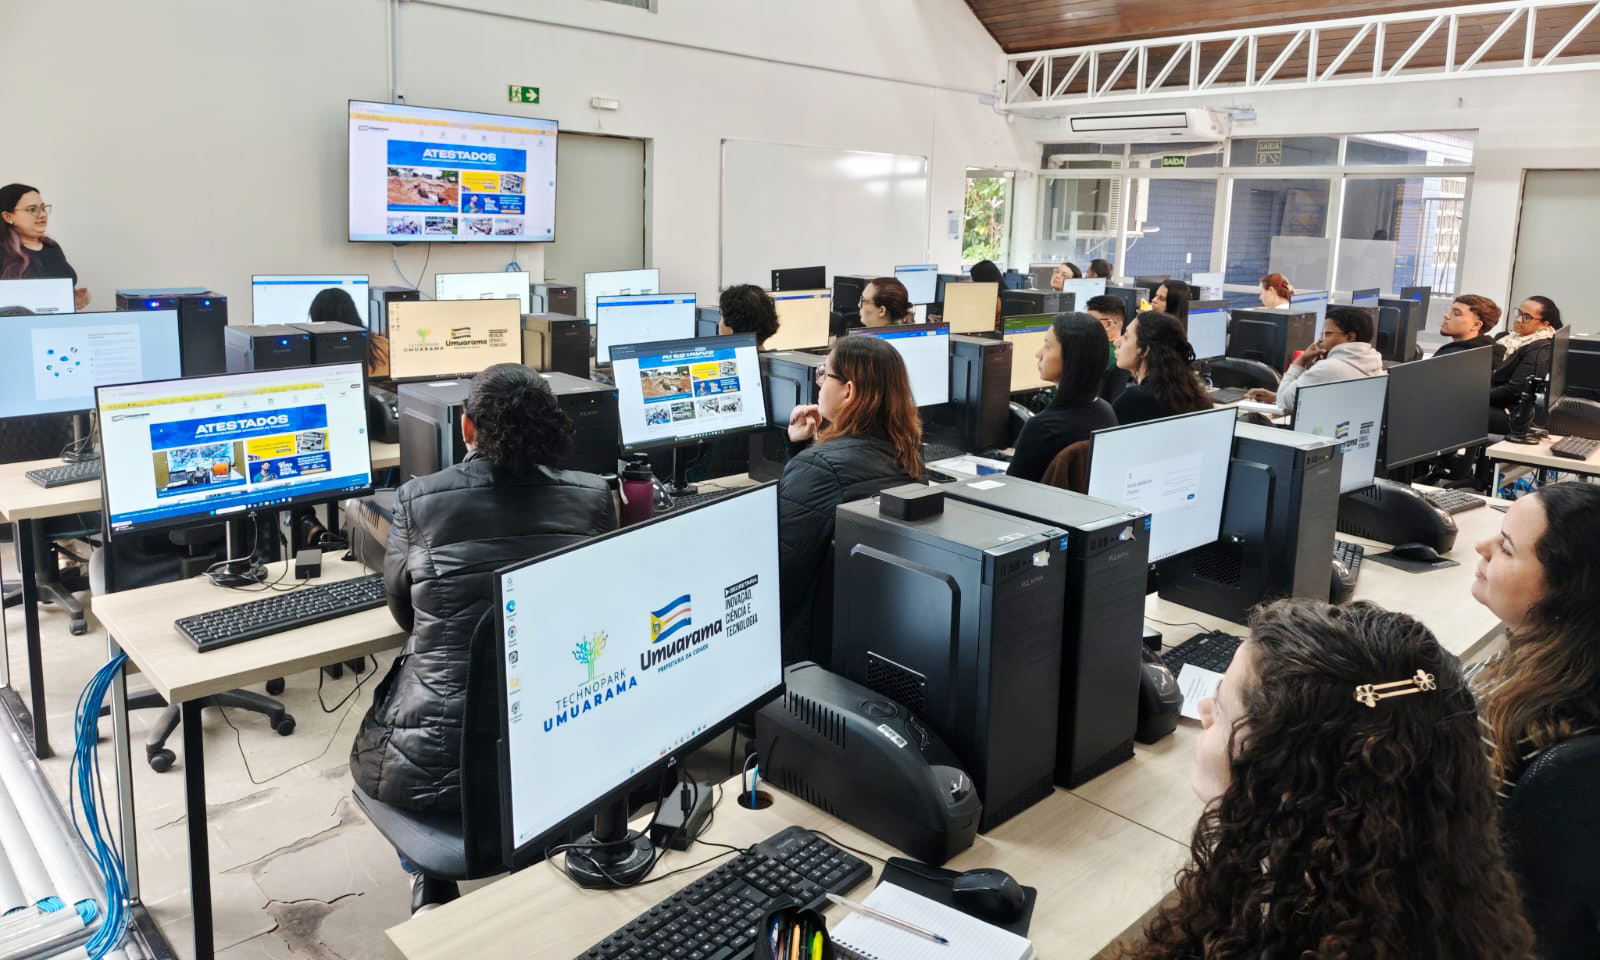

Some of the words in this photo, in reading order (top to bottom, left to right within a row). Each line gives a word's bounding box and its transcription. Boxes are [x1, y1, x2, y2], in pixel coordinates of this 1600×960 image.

[423, 148, 497, 162] ATESTADOS
[1163, 156, 1184, 165] SAÍDA
[445, 339, 487, 347] Umuarama
[195, 414, 289, 434] ATESTADOS
[725, 604, 746, 624] CIÊNCIA
[747, 602, 751, 614] E
[726, 612, 758, 638] TECNOLOGIA
[640, 618, 723, 671] Umuarama
[657, 655, 685, 673] PREFEITURA
[692, 643, 709, 656] CIDADE
[555, 667, 626, 711] TECHNOPARK
[543, 675, 638, 732] UMUARAMA
